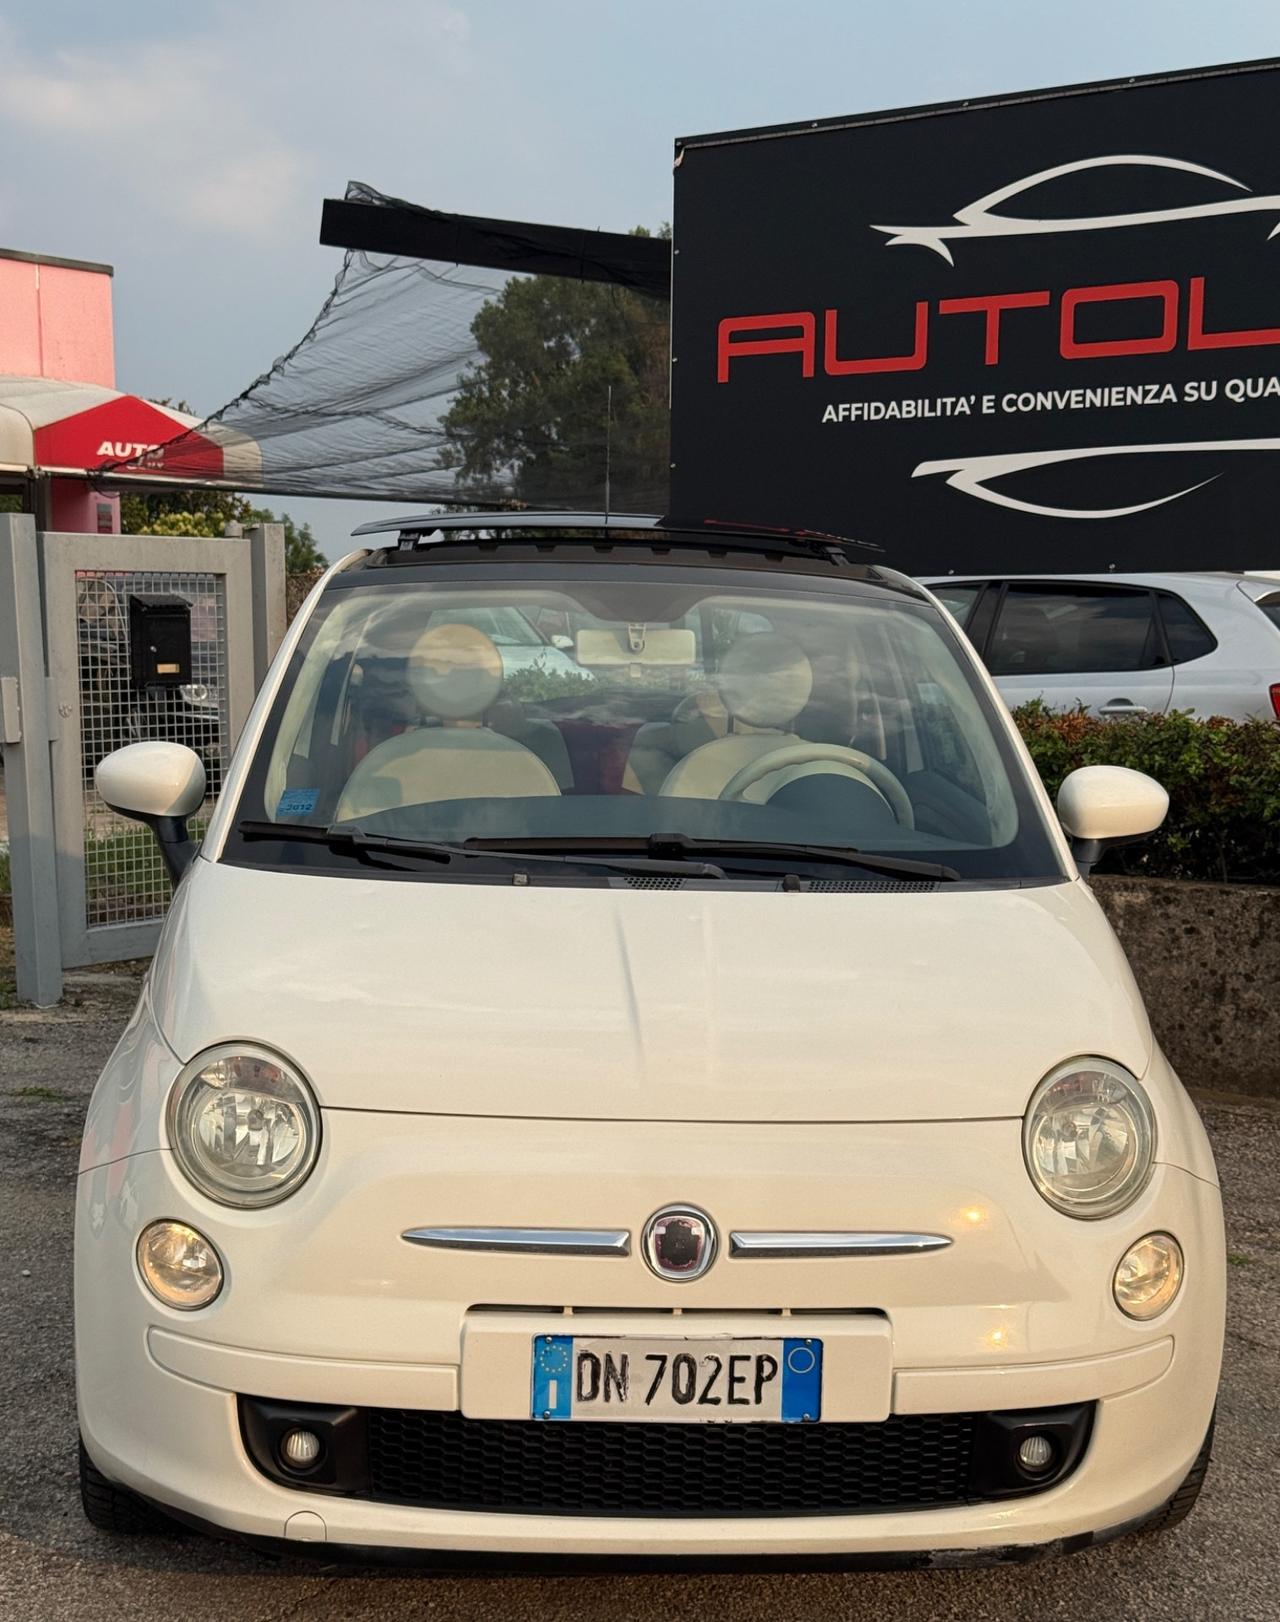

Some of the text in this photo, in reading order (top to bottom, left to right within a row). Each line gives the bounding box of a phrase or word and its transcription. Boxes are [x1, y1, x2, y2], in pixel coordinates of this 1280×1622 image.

[717, 276, 1280, 384] AUTOL
[983, 394, 996, 414] E
[1001, 384, 1179, 414] CONVENIENZA
[1183, 381, 1217, 402] SU
[1224, 376, 1280, 401] QUA
[576, 1351, 629, 1402] DN
[645, 1353, 778, 1405] 702EP
